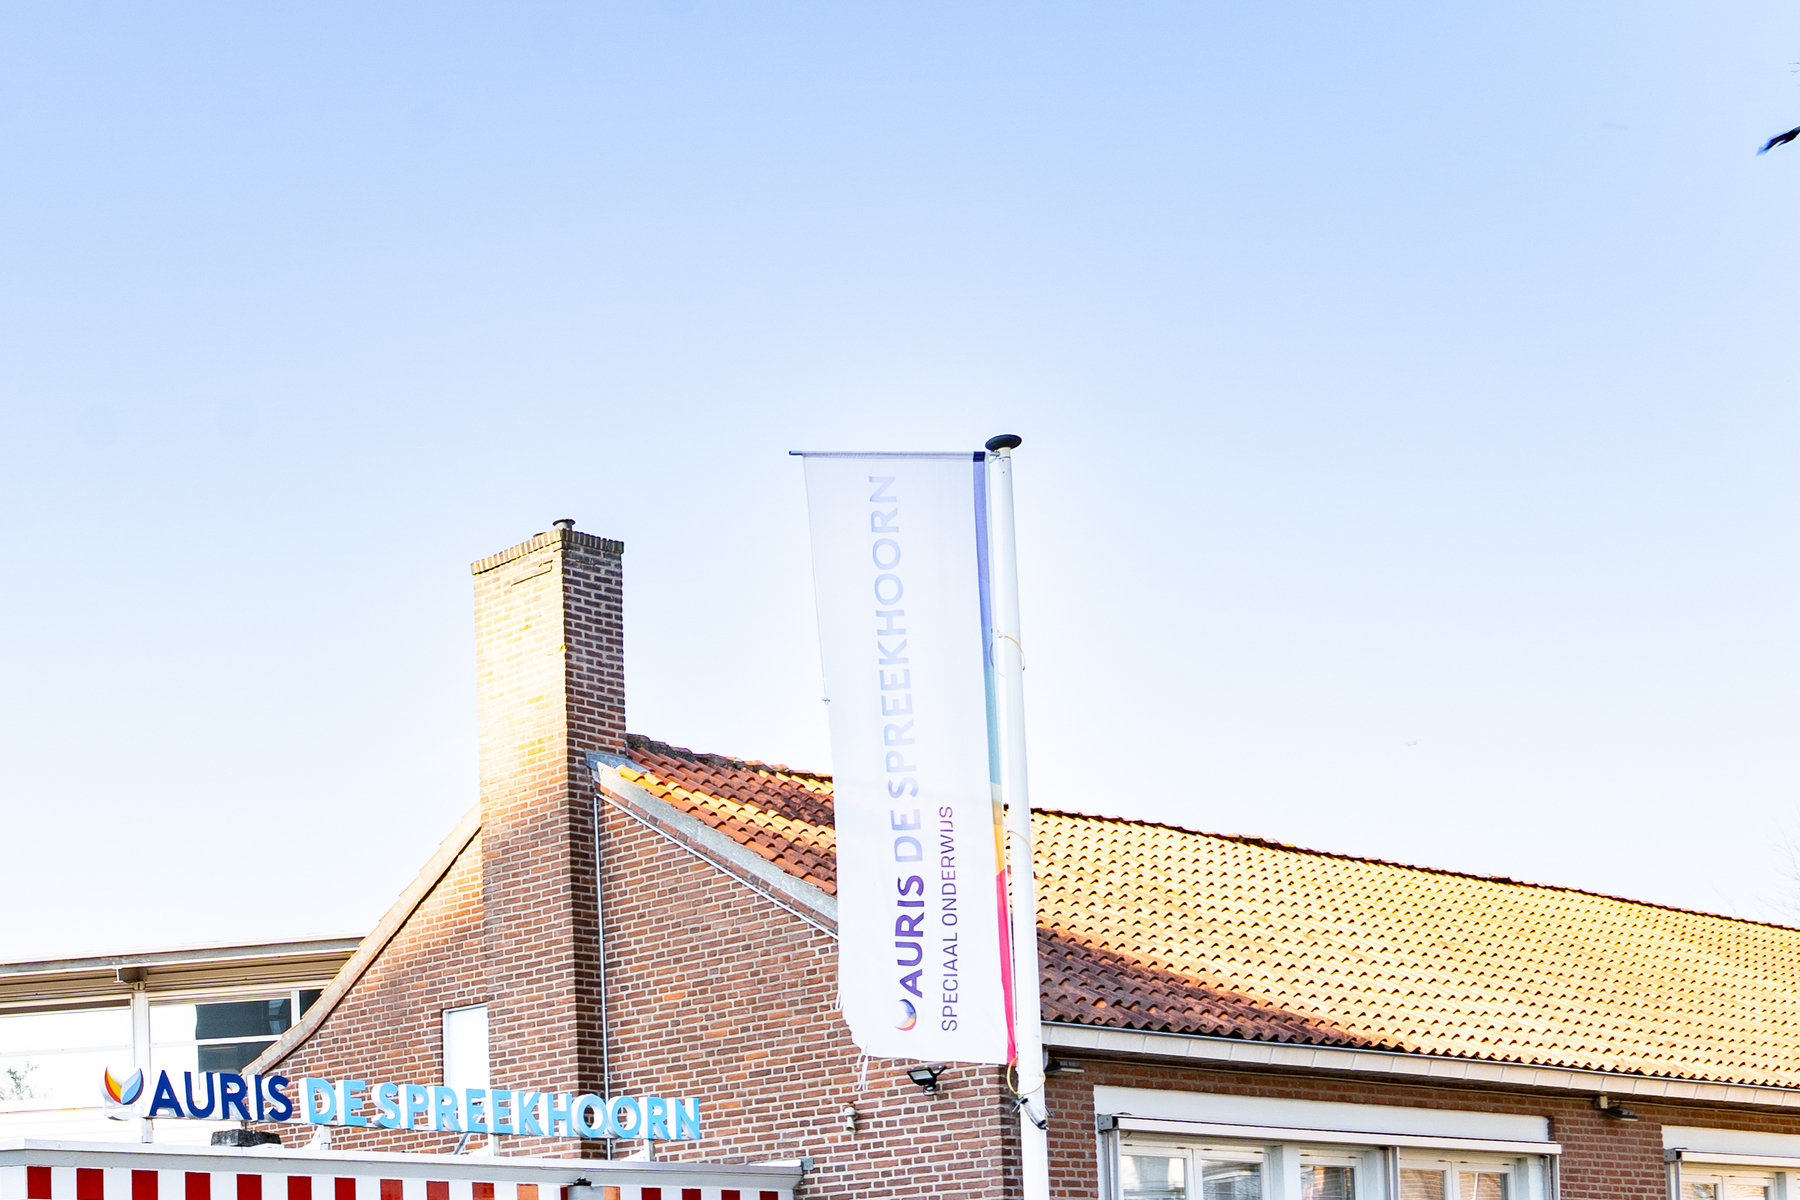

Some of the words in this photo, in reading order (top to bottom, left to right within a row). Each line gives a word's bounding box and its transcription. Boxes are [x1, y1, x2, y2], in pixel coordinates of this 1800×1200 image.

[868, 475, 919, 799] SPREEKHOORN
[890, 809, 922, 863] DE
[939, 806, 958, 926] ONDERWIJS
[894, 875, 925, 998] AURIS
[941, 932, 958, 1032] SPECIAAL
[148, 1069, 293, 1122] AURIS
[299, 1077, 367, 1127] DE
[371, 1081, 700, 1140] SPREEKHOORN
